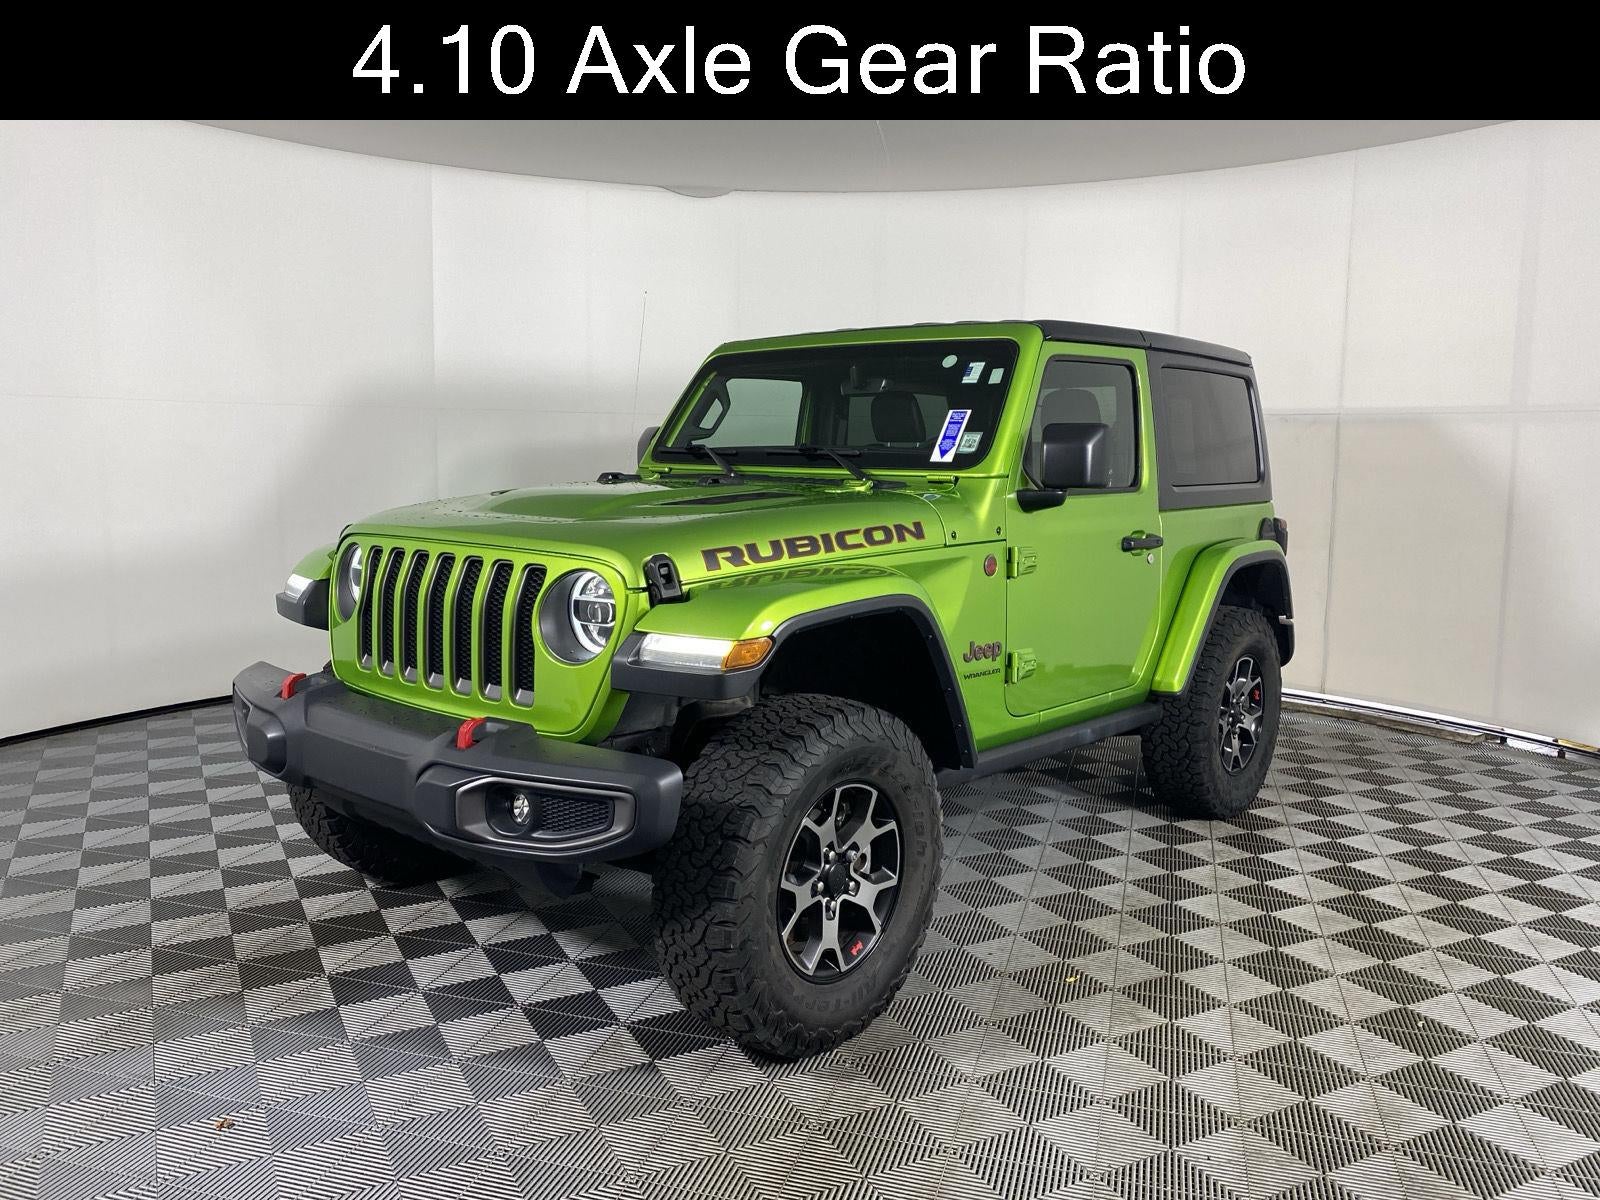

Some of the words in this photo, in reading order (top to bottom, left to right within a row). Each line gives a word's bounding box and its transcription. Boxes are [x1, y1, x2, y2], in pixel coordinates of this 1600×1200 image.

[700, 521, 926, 572] RUBICON
[963, 641, 1002, 663] Jeep
[964, 667, 1001, 681] WRANGLER
